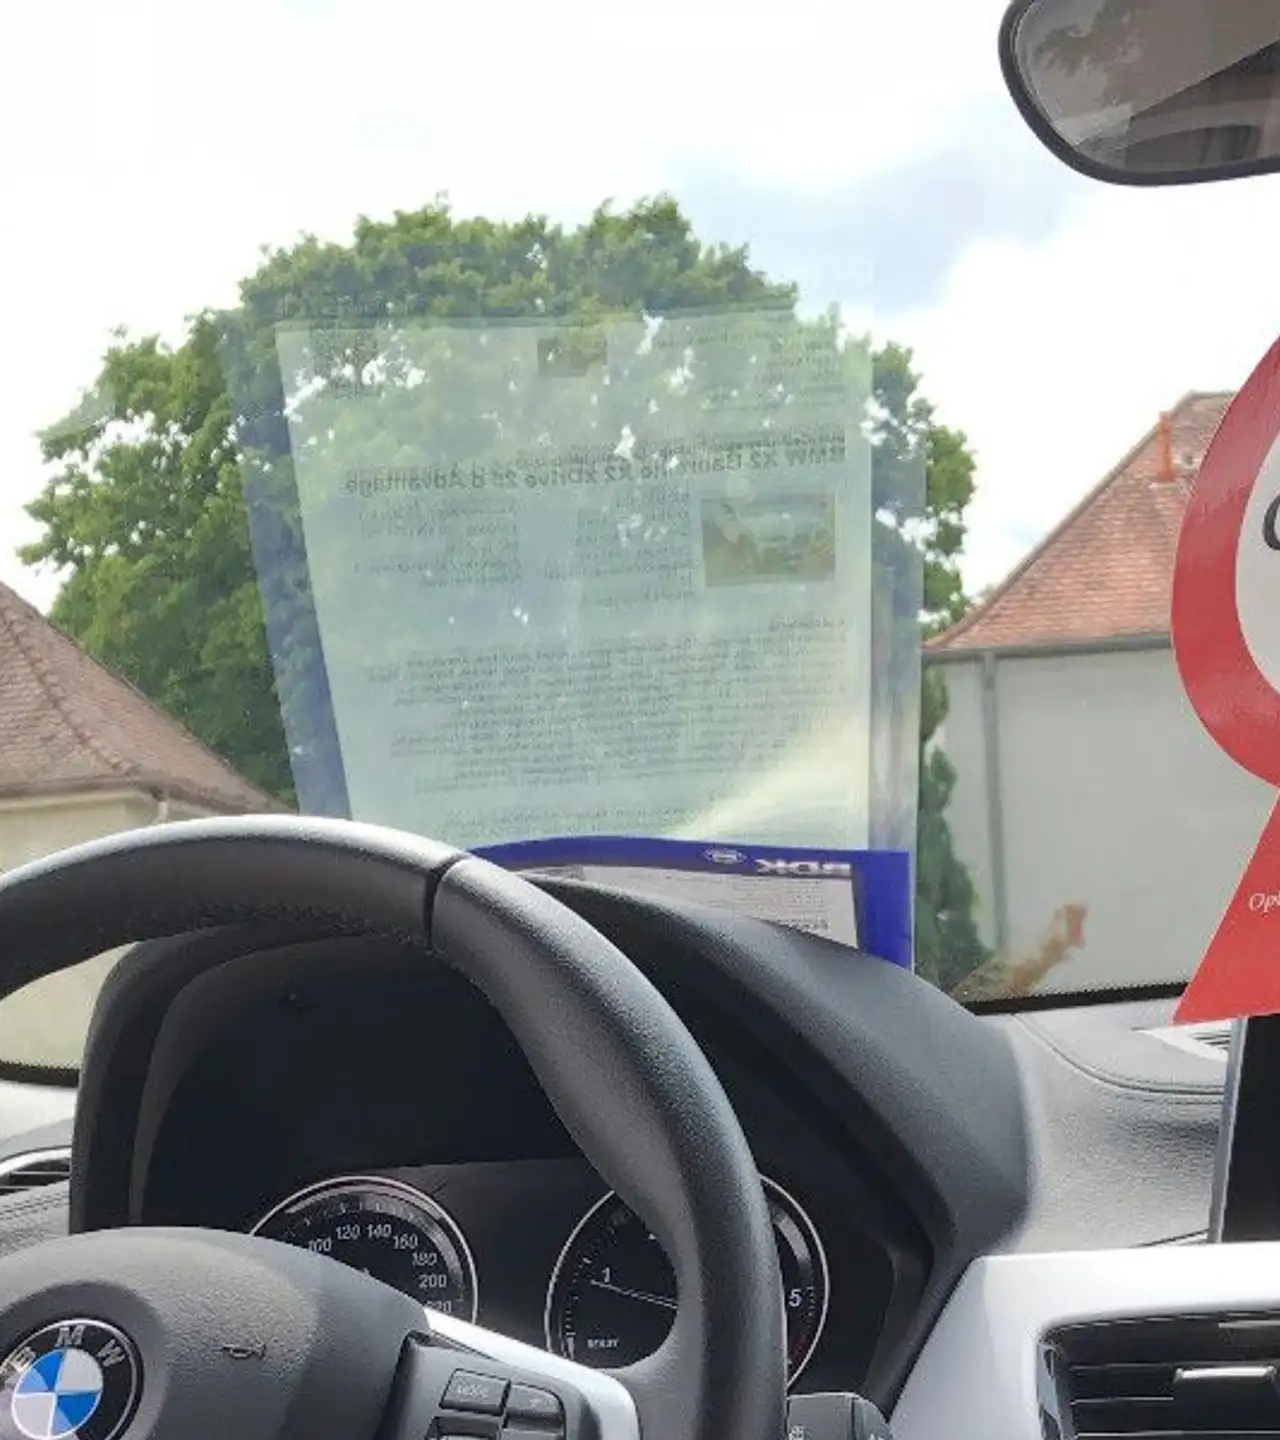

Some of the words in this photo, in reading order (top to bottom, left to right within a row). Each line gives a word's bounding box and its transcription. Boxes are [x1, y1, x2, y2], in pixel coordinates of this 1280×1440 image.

[336, 1224, 360, 1240] 120
[367, 1223, 392, 1239] 140
[394, 1233, 419, 1250] 160
[412, 1251, 437, 1266] 180
[419, 1274, 448, 1289] 200
[601, 1266, 612, 1283] 1
[788, 1288, 802, 1307] 5
[13, 1324, 125, 1372] BMW
